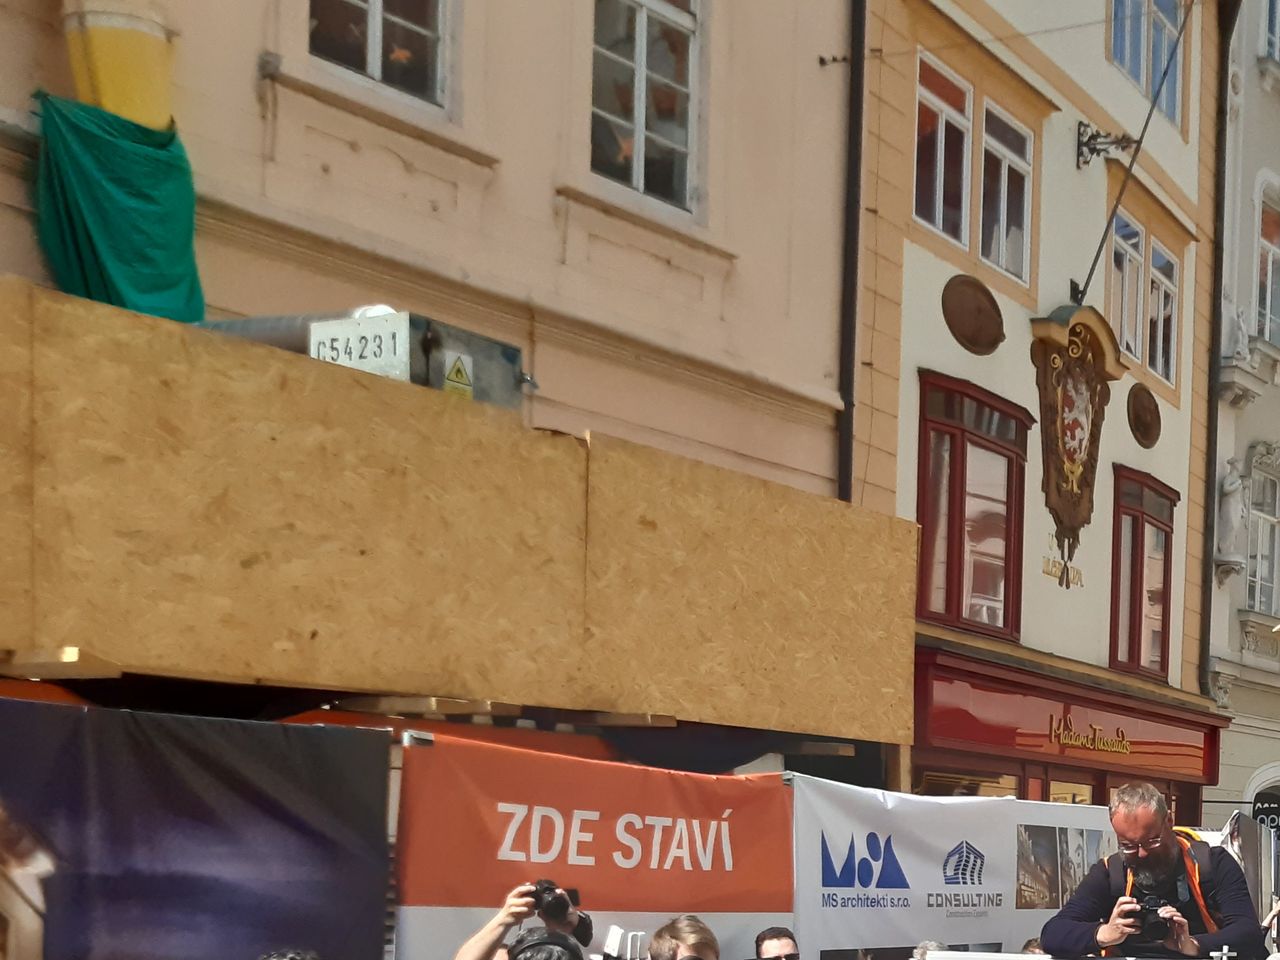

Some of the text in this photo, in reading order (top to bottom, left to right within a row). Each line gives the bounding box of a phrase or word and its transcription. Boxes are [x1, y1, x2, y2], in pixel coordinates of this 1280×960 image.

[497, 802, 733, 871] ZDE STAVÍ
[822, 892, 911, 908] MS architekti s.r.o.
[927, 893, 1002, 907] CONSULTING
